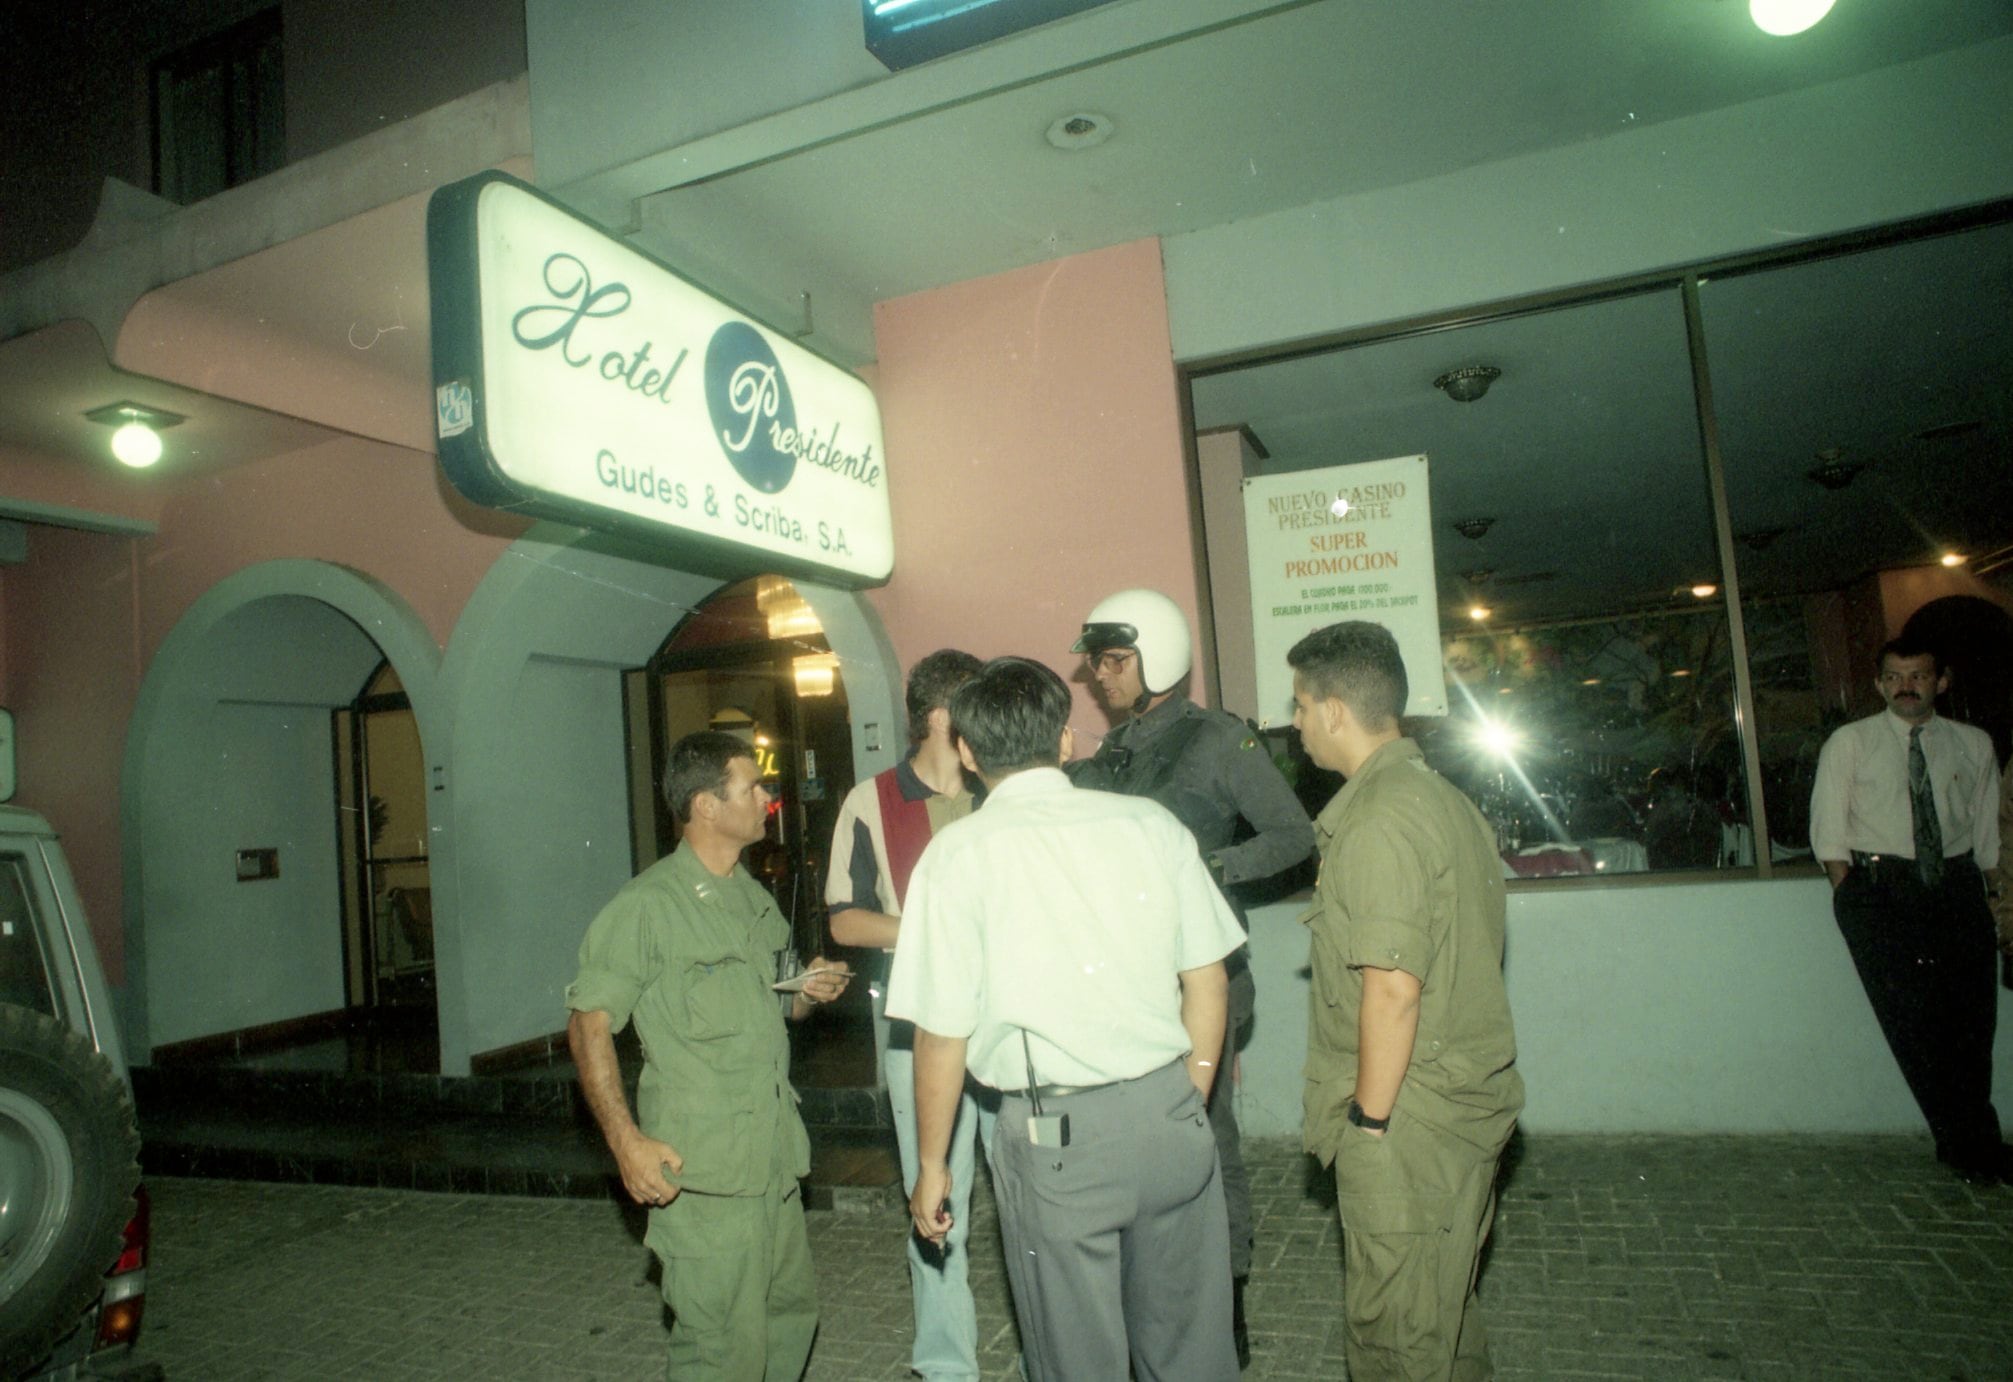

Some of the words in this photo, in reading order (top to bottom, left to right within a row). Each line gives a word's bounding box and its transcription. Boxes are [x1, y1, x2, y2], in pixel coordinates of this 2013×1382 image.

[511, 252, 689, 404] Hotel
[723, 361, 880, 488] Presidente
[597, 448, 689, 509] Gudes
[704, 485, 721, 518] &
[1268, 490, 1326, 514] NUEVO
[1337, 481, 1406, 503] CASINO
[1285, 551, 1399, 579] PROMOCION
[1310, 531, 1368, 553] SUPER
